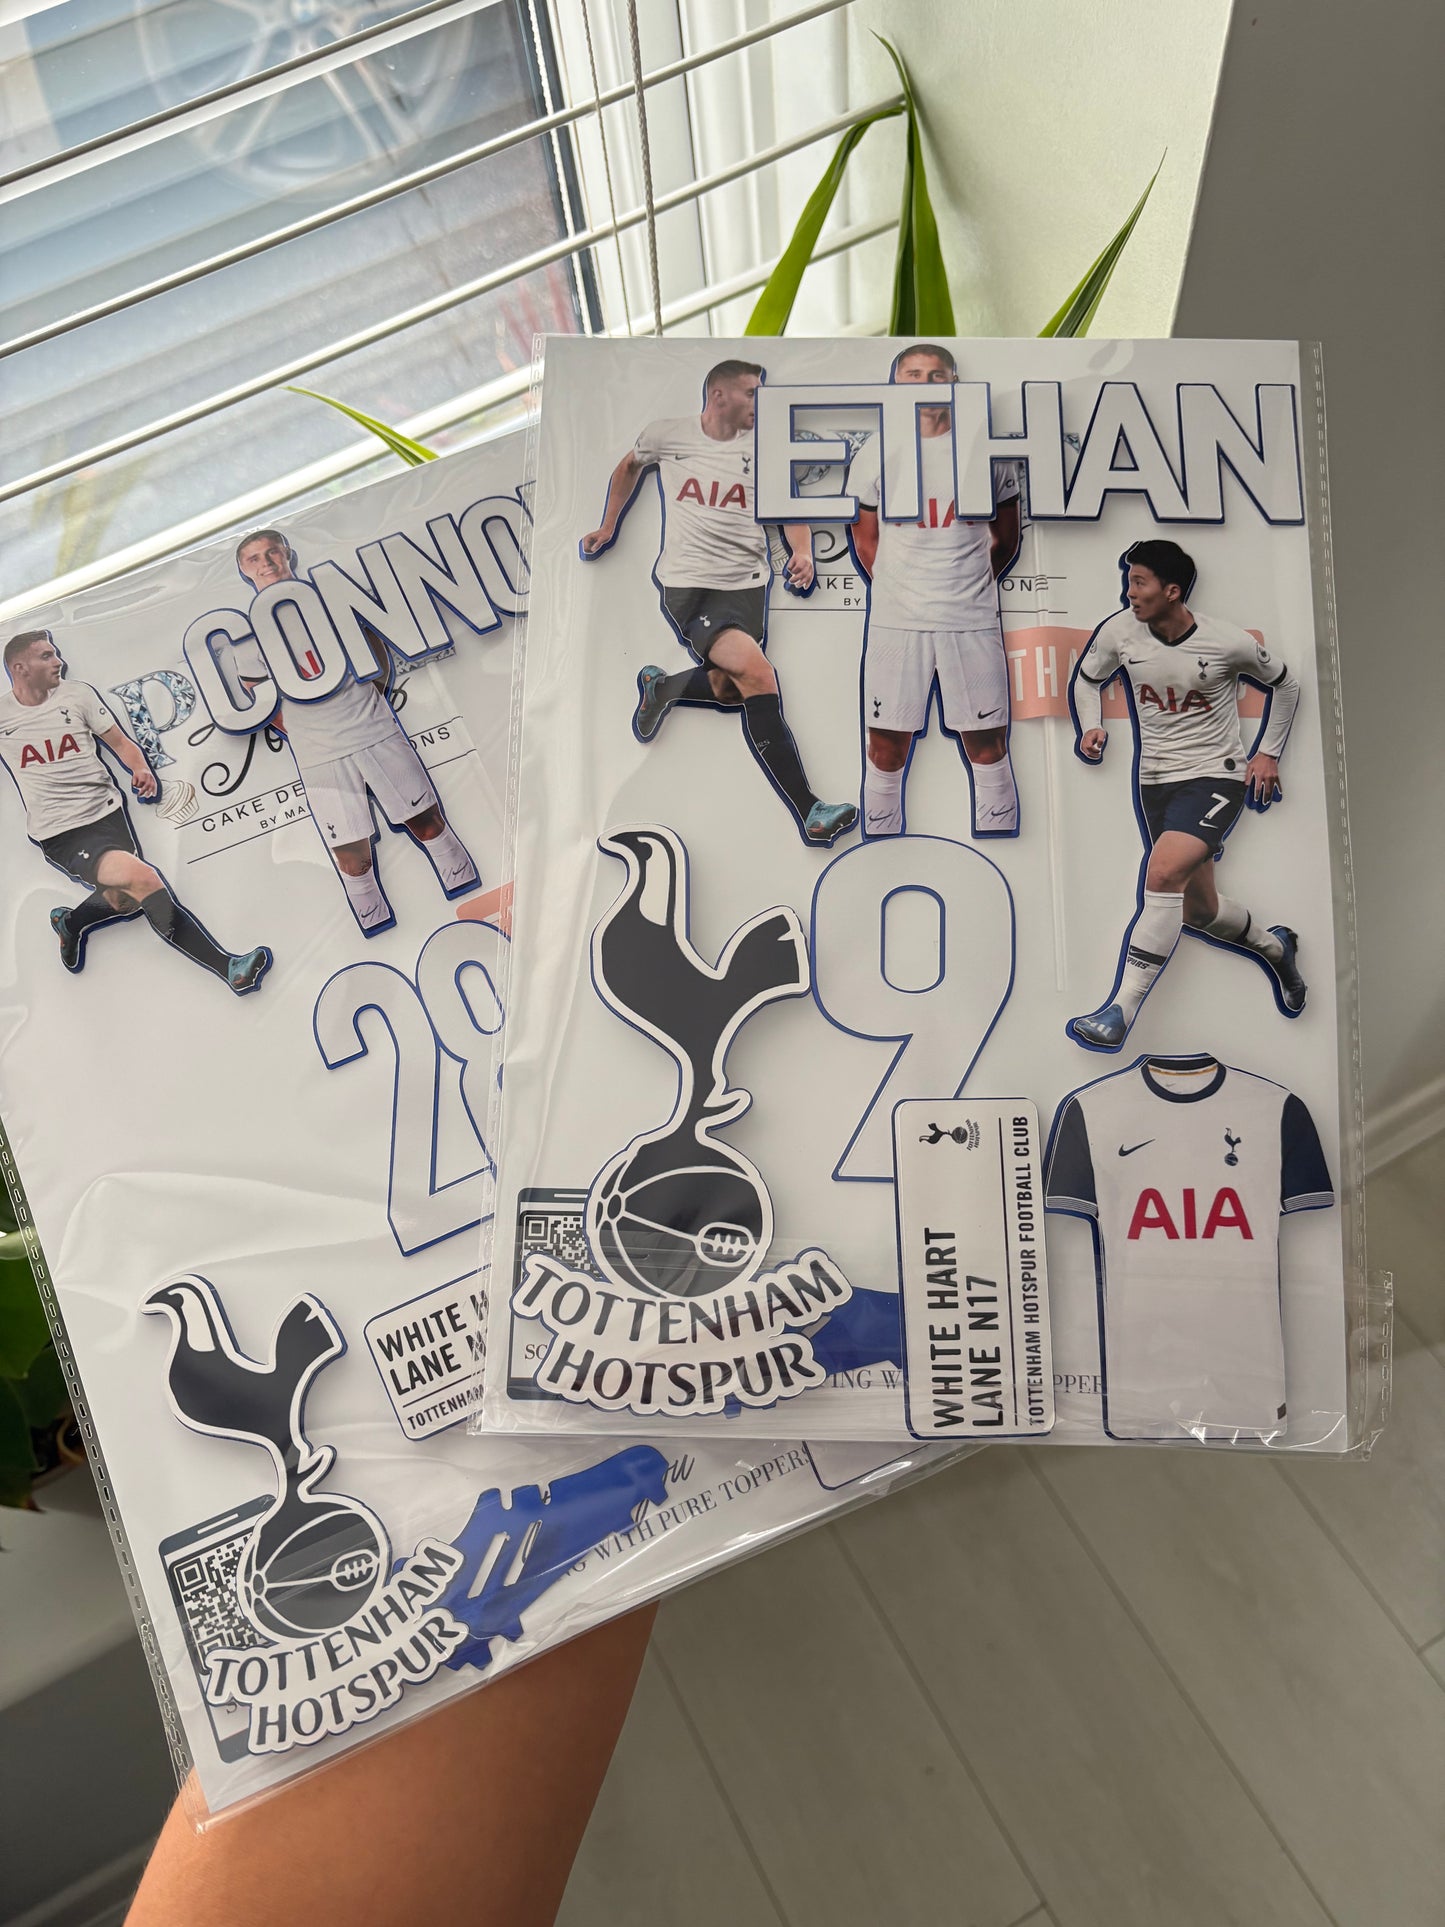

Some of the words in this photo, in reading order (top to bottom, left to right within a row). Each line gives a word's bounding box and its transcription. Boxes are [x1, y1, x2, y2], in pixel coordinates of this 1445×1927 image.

[754, 381, 1305, 526] ETHAN
[676, 477, 748, 509] AIA
[183, 481, 535, 736] CONNO
[843, 597, 861, 606] BY
[1139, 683, 1213, 713] AIA
[20, 733, 81, 769] AIA
[201, 799, 266, 833] CAKE
[259, 814, 278, 830] BY
[1205, 792, 1231, 820] 7
[1126, 956, 1150, 970] PURS
[810, 834, 1016, 1182] 9
[1012, 1116, 1029, 1156] CLUB
[1015, 1163, 1035, 1241] FOOTBALL
[1127, 1187, 1254, 1240] AIA
[924, 1227, 960, 1309] HART
[1020, 1249, 1040, 1324] HOTSPUR
[376, 1302, 467, 1362] WHITE
[522, 1260, 843, 1344] TOTTENHAM
[966, 1275, 999, 1330] N17
[389, 1342, 462, 1396] LANE
[546, 1341, 816, 1406] HOTSPUR
[928, 1323, 965, 1428] WHITE
[968, 1346, 1004, 1427] LANE
[1024, 1330, 1044, 1426] TOTTENHAM
[593, 1519, 657, 1561] WITH
[657, 1490, 718, 1533] PURE
[212, 1546, 457, 1697] TOTTENHAM
[256, 1616, 460, 1746] HOTSPUR
